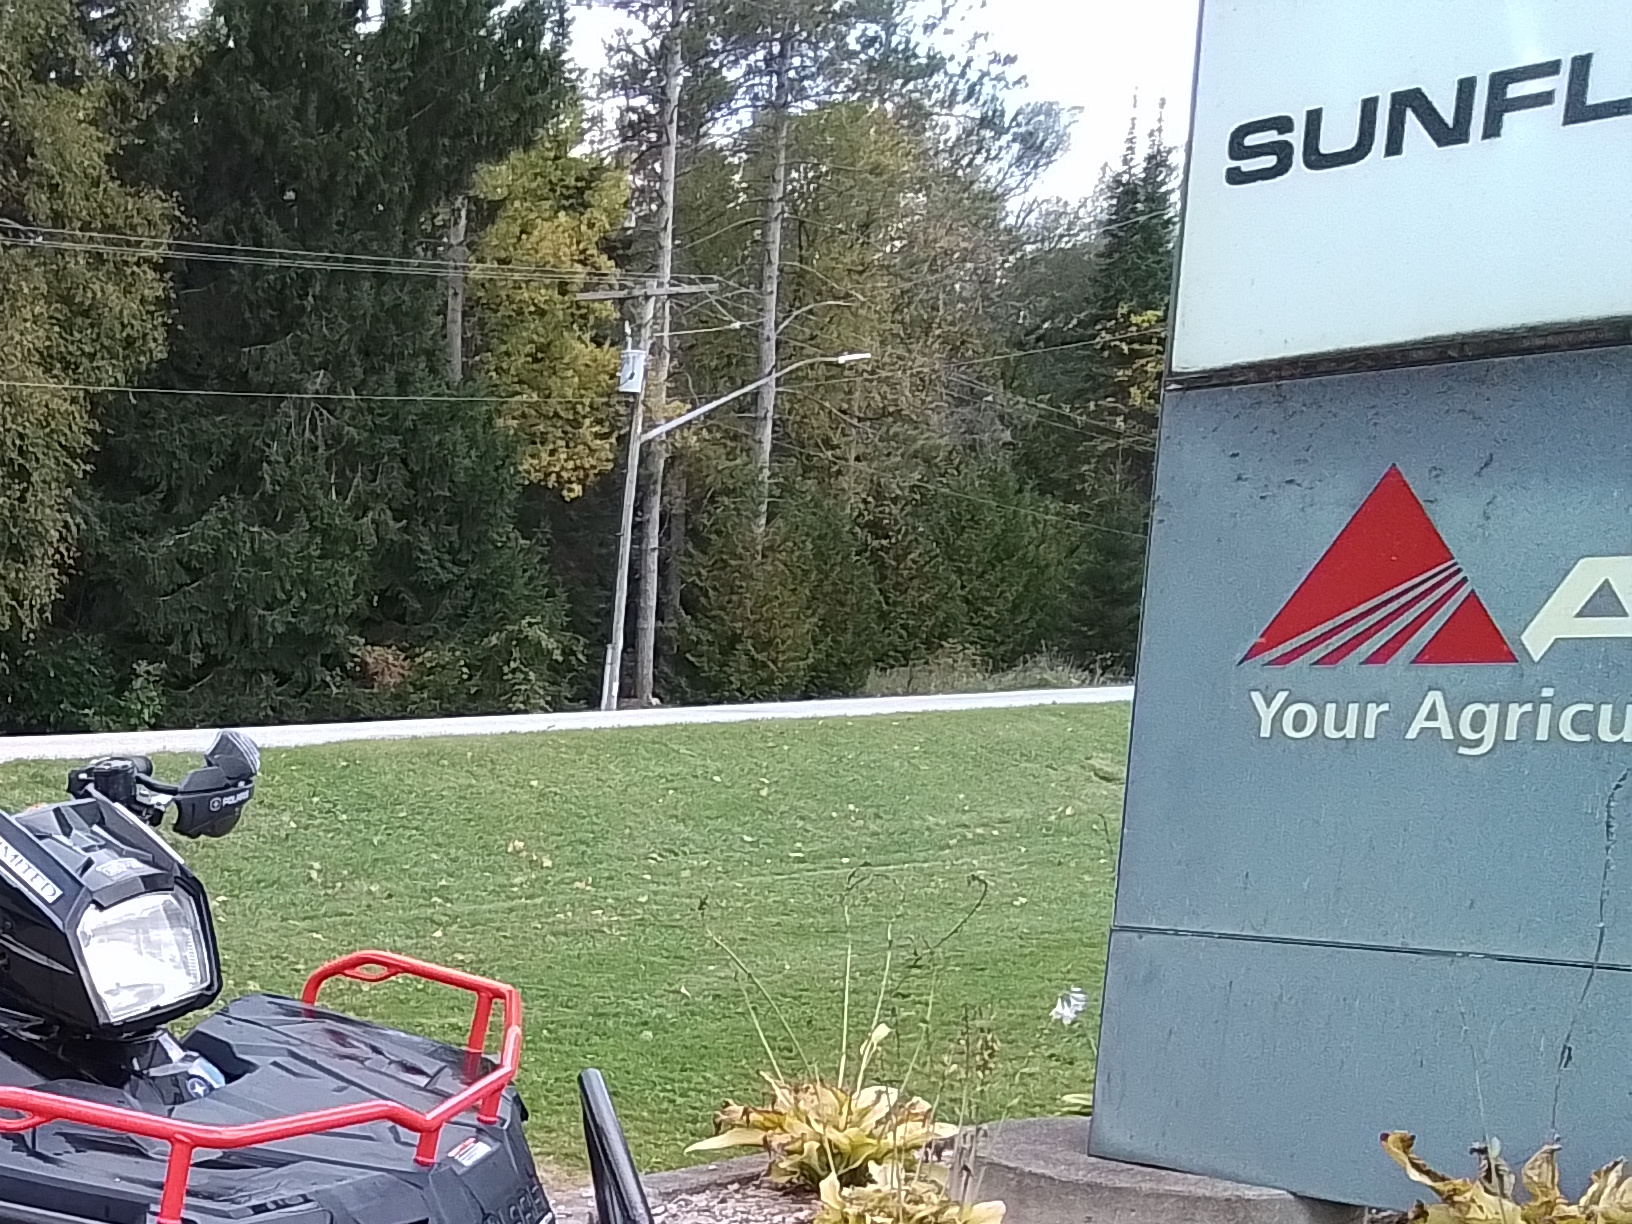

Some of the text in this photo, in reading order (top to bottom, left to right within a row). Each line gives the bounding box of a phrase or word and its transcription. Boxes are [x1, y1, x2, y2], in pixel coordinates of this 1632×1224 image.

[1225, 52, 1632, 186] SUNFL
[1250, 687, 1632, 757] Your Agricu
